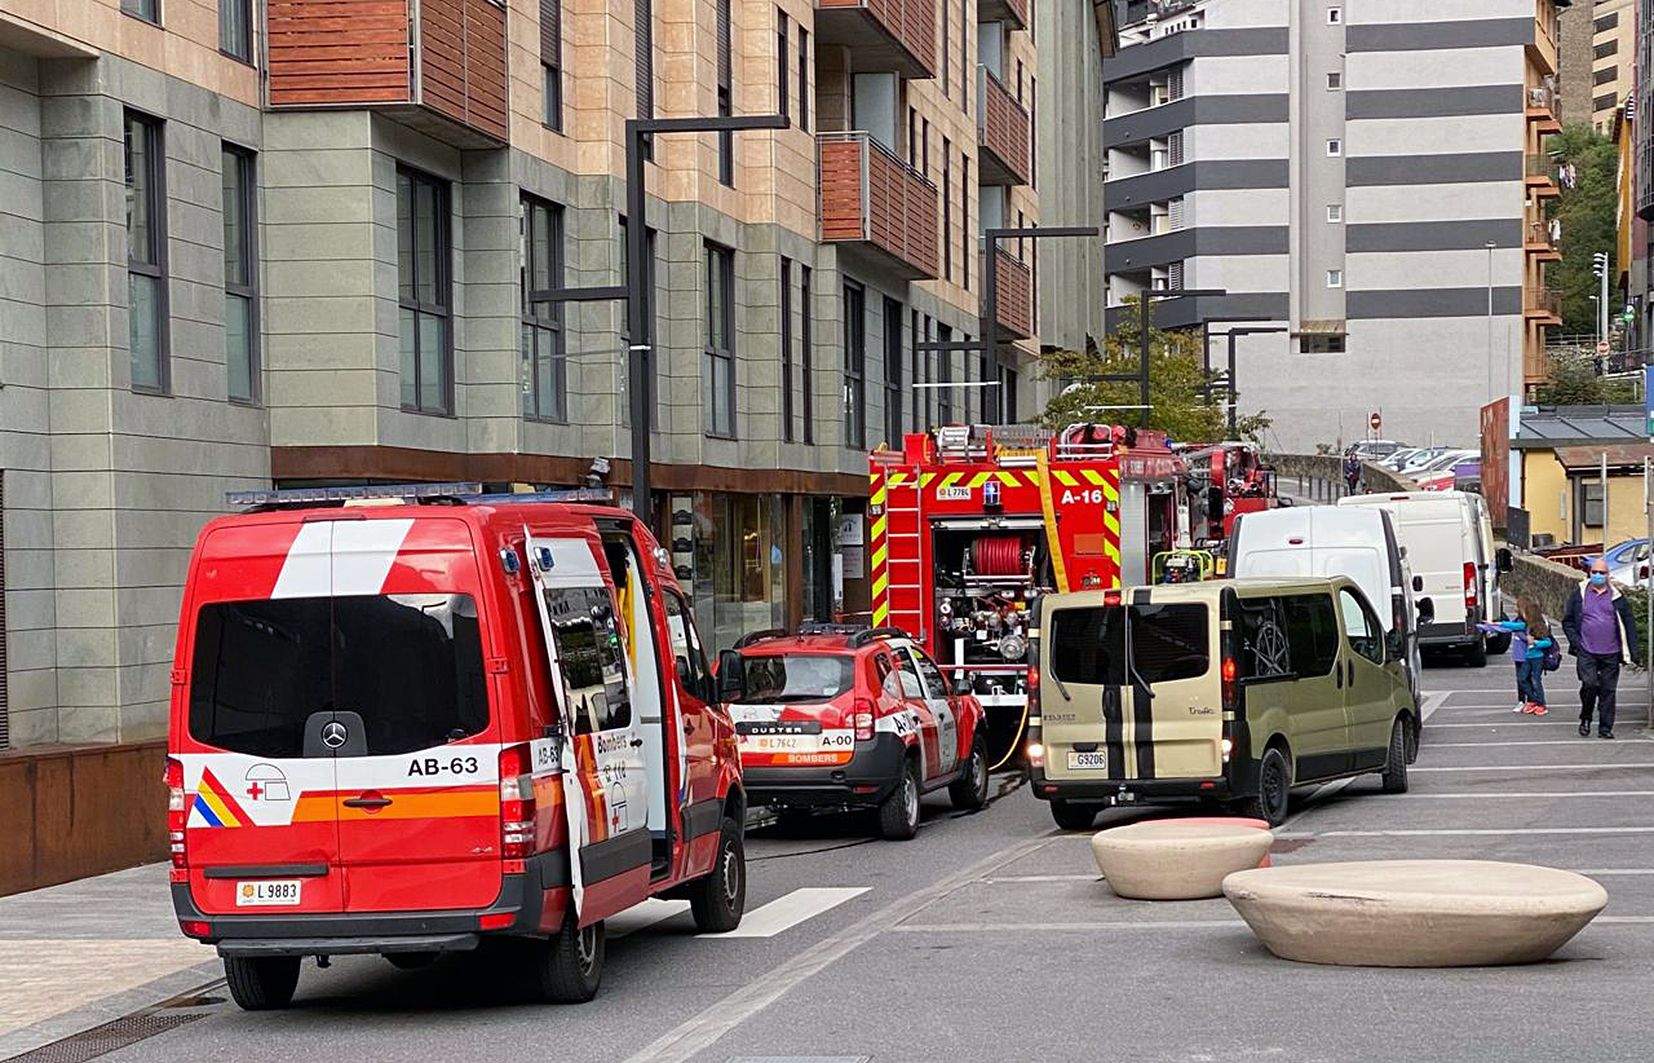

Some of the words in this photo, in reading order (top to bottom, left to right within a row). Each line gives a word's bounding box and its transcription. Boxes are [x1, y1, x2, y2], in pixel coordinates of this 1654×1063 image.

[1061, 489, 1103, 504] A-16
[823, 735, 852, 746] A-00
[538, 745, 559, 765] AB-63
[788, 754, 839, 763] BOMBERS
[408, 757, 478, 776] AB-63
